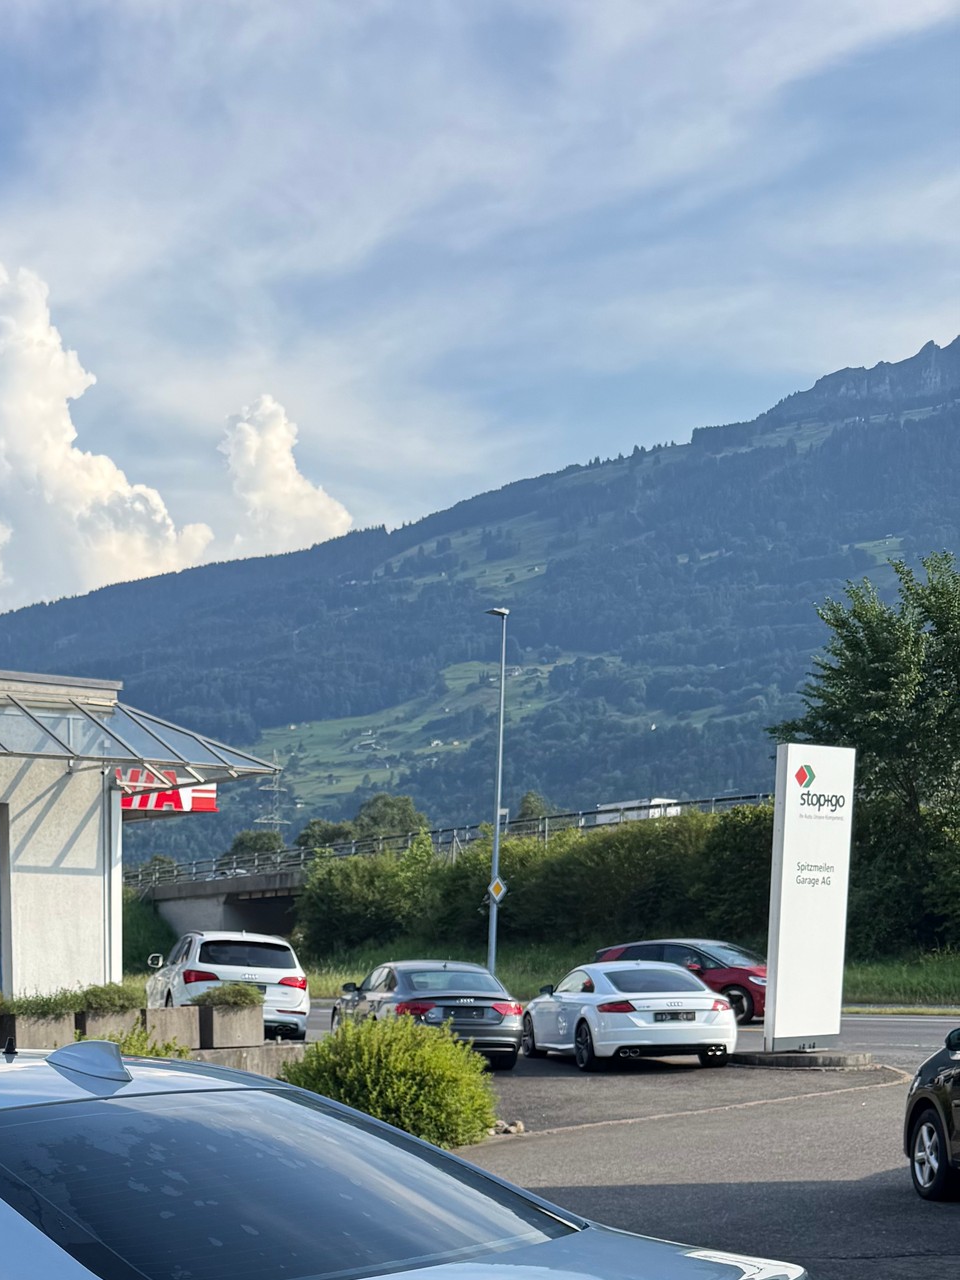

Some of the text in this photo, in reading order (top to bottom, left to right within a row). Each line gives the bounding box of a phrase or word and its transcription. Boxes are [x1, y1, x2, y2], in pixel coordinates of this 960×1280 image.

[800, 790, 846, 812] stop+go
[796, 862, 835, 873] Spitzmeilen
[796, 875, 831, 887] Garage AG
